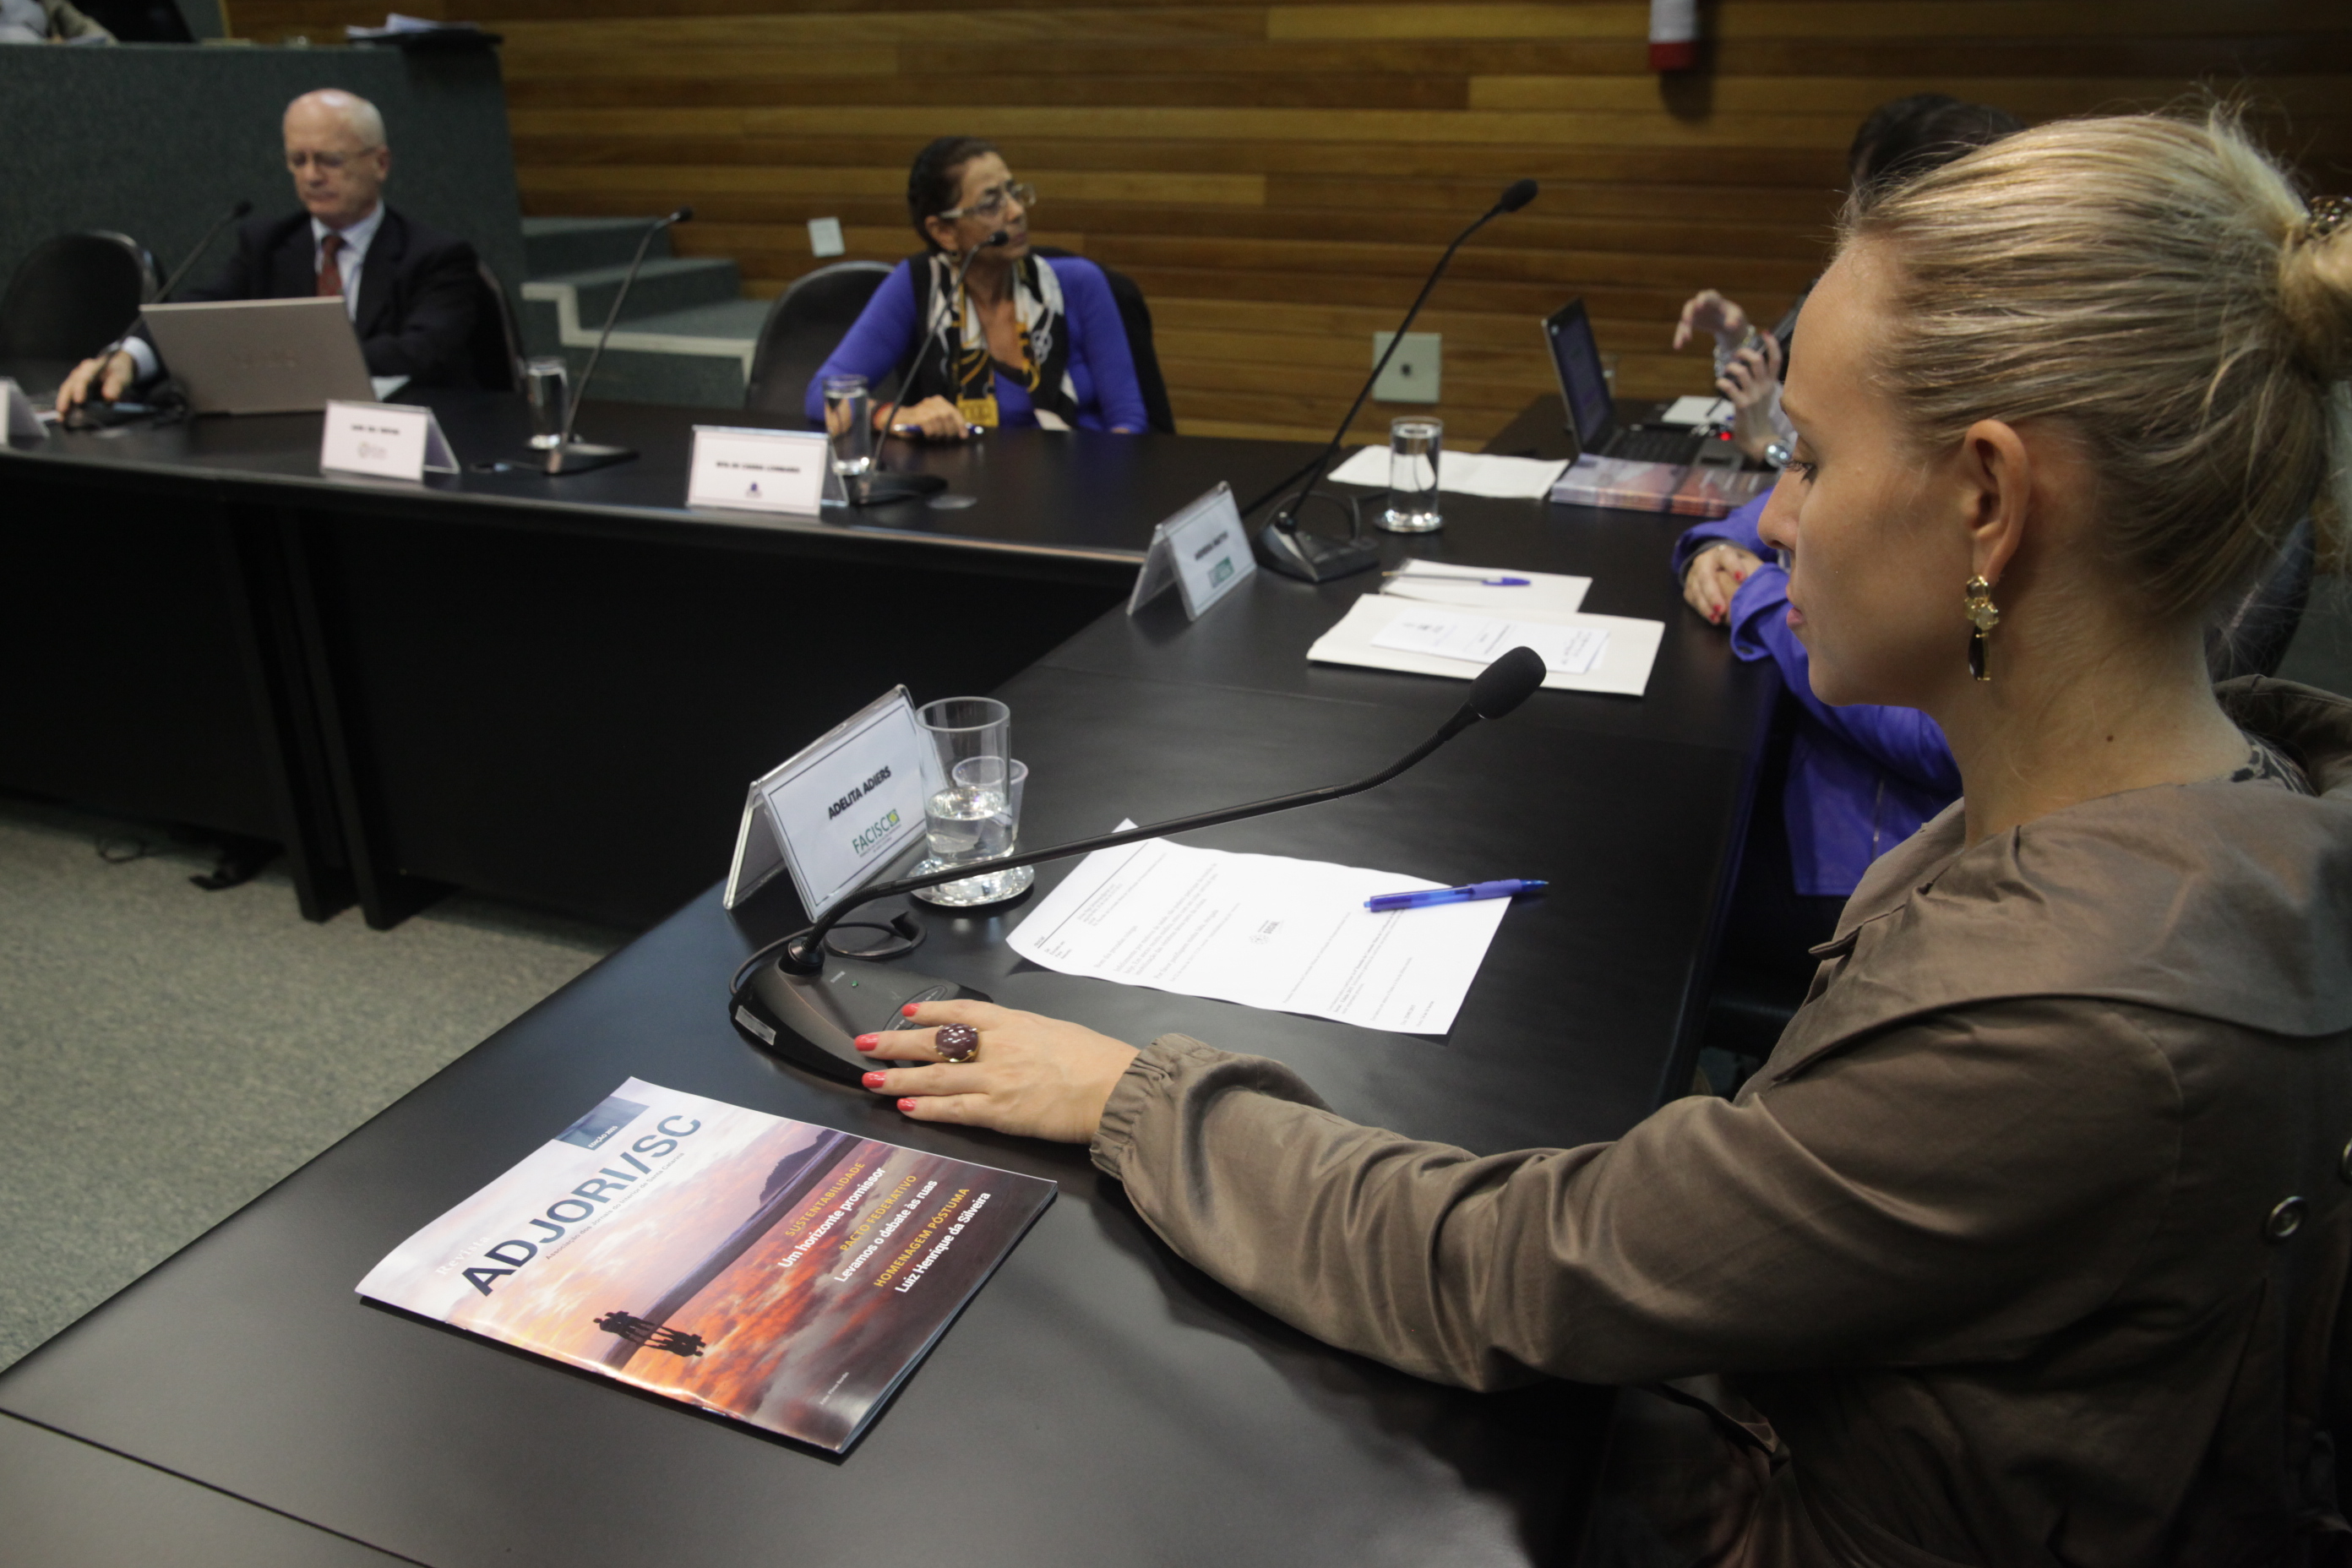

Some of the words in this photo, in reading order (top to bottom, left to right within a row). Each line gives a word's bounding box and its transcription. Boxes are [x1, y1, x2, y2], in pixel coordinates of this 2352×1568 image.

[828, 787, 863, 820] ADELITA
[863, 765, 891, 794] ADIERS
[852, 816, 890, 854] FACISC
[461, 1115, 701, 1297] ADJORI/SC
[546, 1233, 580, 1260] Associação
[580, 1225, 592, 1234] dos
[591, 1209, 613, 1225] Jornais
[619, 1188, 640, 1204] Interior
[646, 1170, 663, 1183] Santa
[662, 1152, 684, 1170] Catarina
[785, 1162, 865, 1237] SUSTENTABILIDADE
[839, 1224, 870, 1252] PACTO
[867, 1175, 917, 1224] FEDERATIVO
[906, 1196, 921, 1211] às
[916, 1179, 938, 1200] ruas
[777, 1248, 803, 1268] Um
[800, 1209, 845, 1252] horizonte
[841, 1167, 886, 1211] promissor
[874, 1229, 933, 1288] HOMENAGEM
[928, 1188, 970, 1229] PÓSTUMA
[874, 1235, 885, 1245] o
[879, 1207, 912, 1237] debate
[895, 1270, 921, 1293] Luiz
[912, 1233, 955, 1274] Henrique
[948, 1222, 965, 1236] da
[957, 1192, 992, 1224] Silveira
[434, 1234, 491, 1276] Revista
[834, 1244, 879, 1282] Levamos
